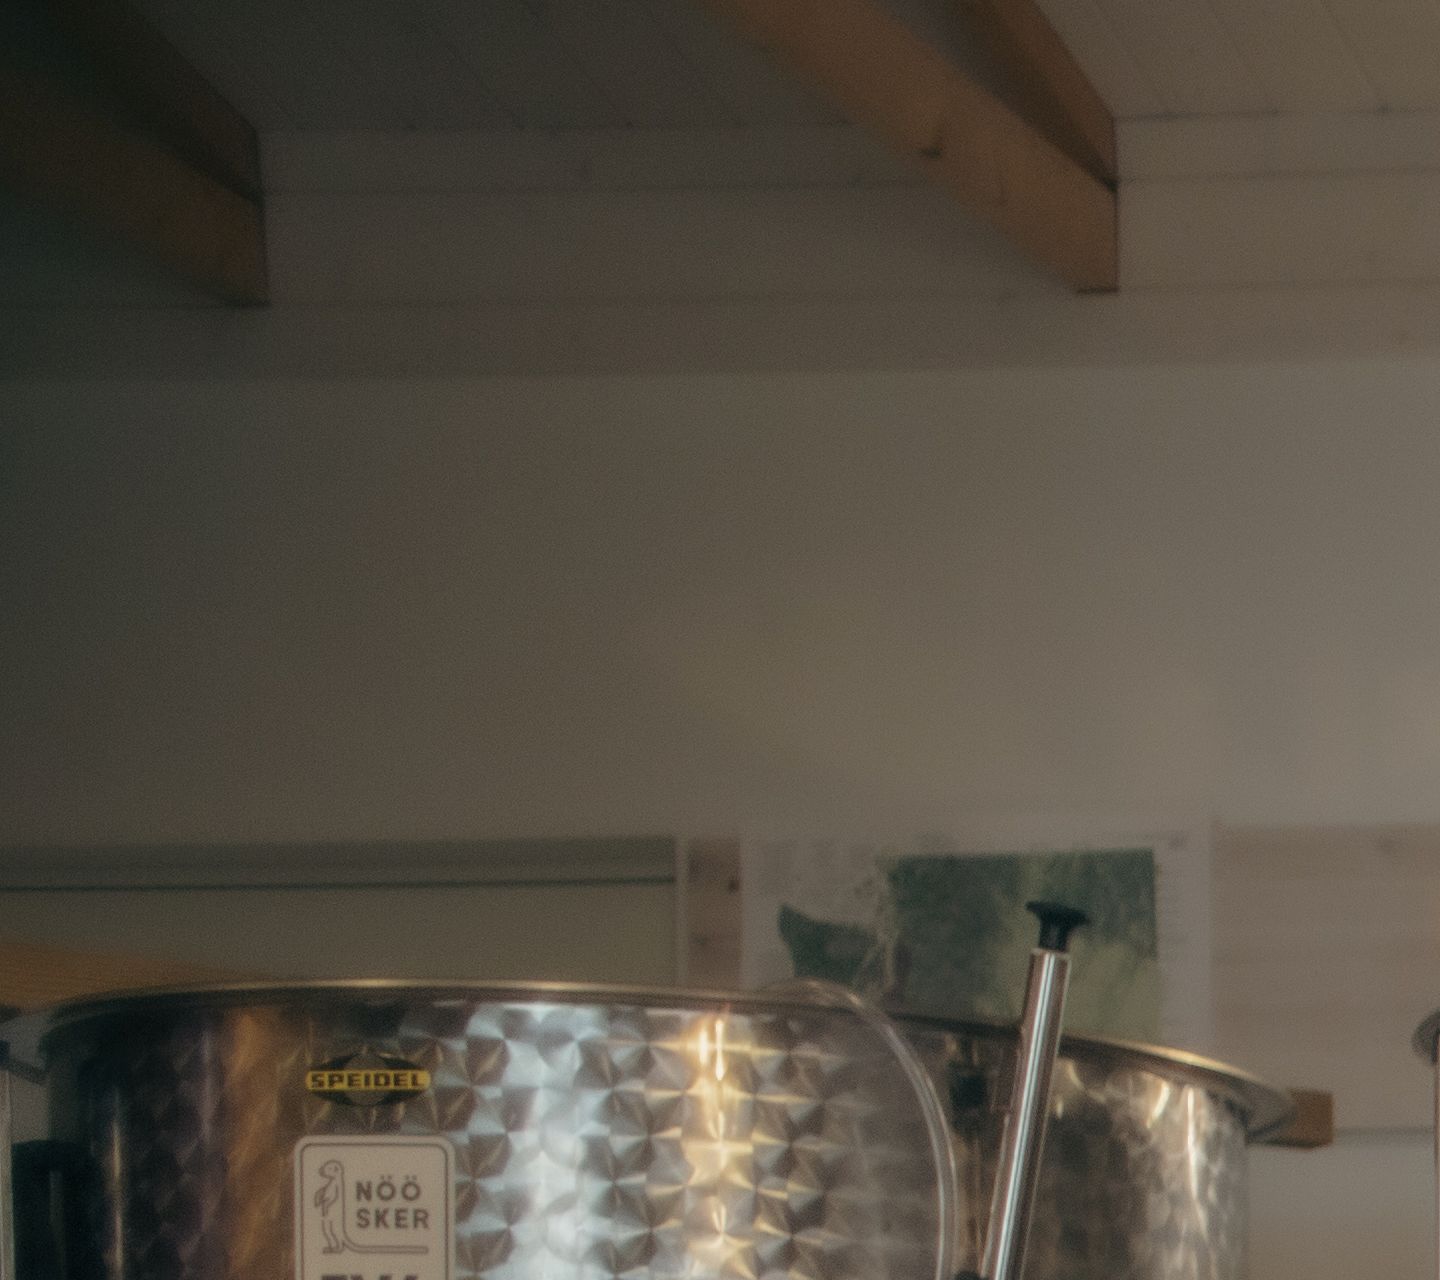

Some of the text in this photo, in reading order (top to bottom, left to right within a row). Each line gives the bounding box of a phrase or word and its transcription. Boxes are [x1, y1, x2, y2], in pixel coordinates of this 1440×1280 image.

[310, 1070, 427, 1090] SPEIDEL
[355, 1175, 422, 1202] NÖÖ
[355, 1207, 430, 1230] SKER
